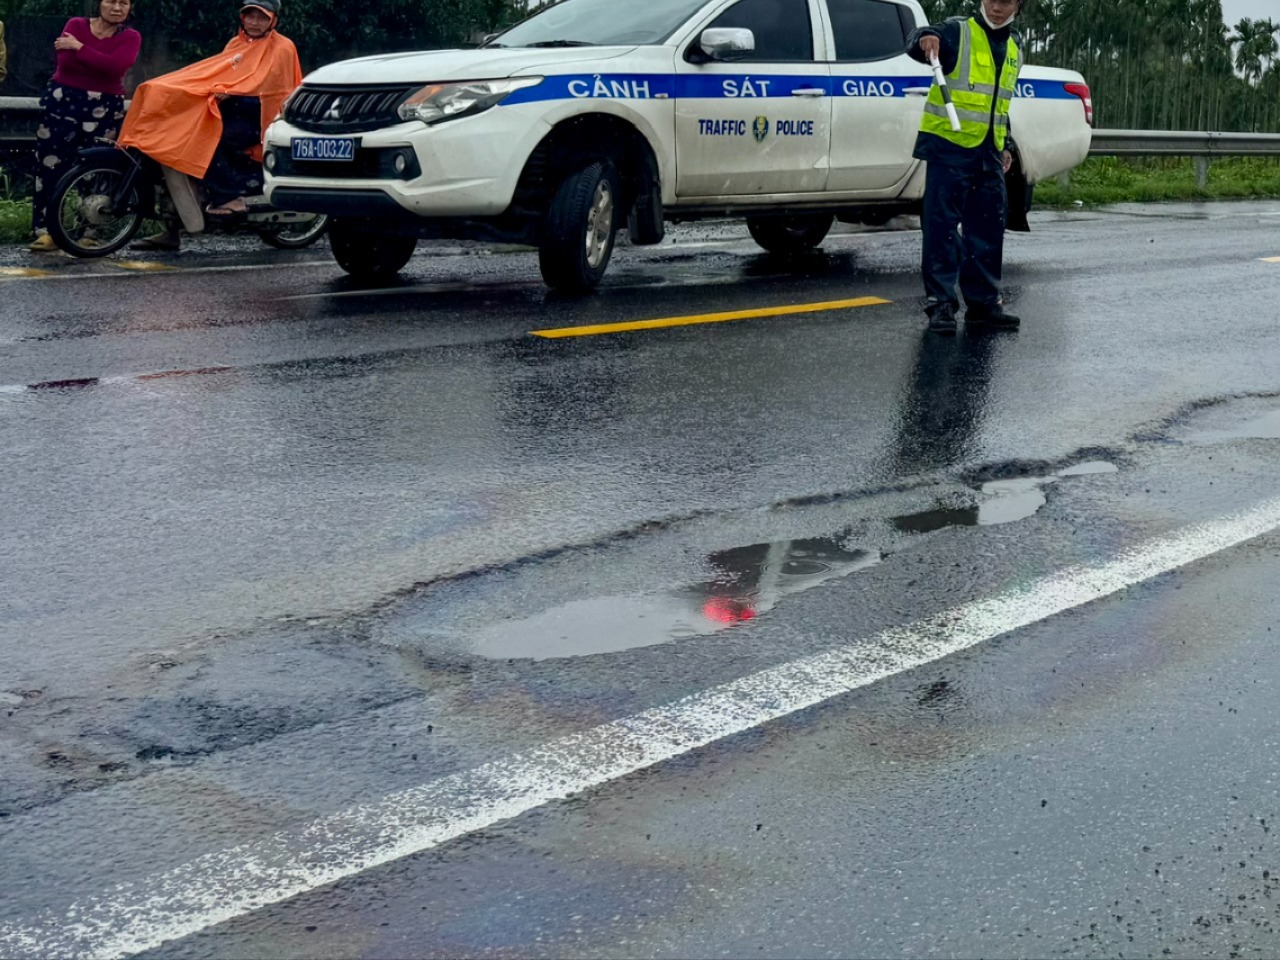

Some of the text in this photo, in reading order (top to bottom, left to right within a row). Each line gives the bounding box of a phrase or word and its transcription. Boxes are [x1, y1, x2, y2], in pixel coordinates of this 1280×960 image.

[568, 74, 650, 99] CẢNH
[723, 76, 771, 98] SÁT
[843, 79, 895, 97] GIAO
[698, 119, 814, 136] TRAFFIC POLICE
